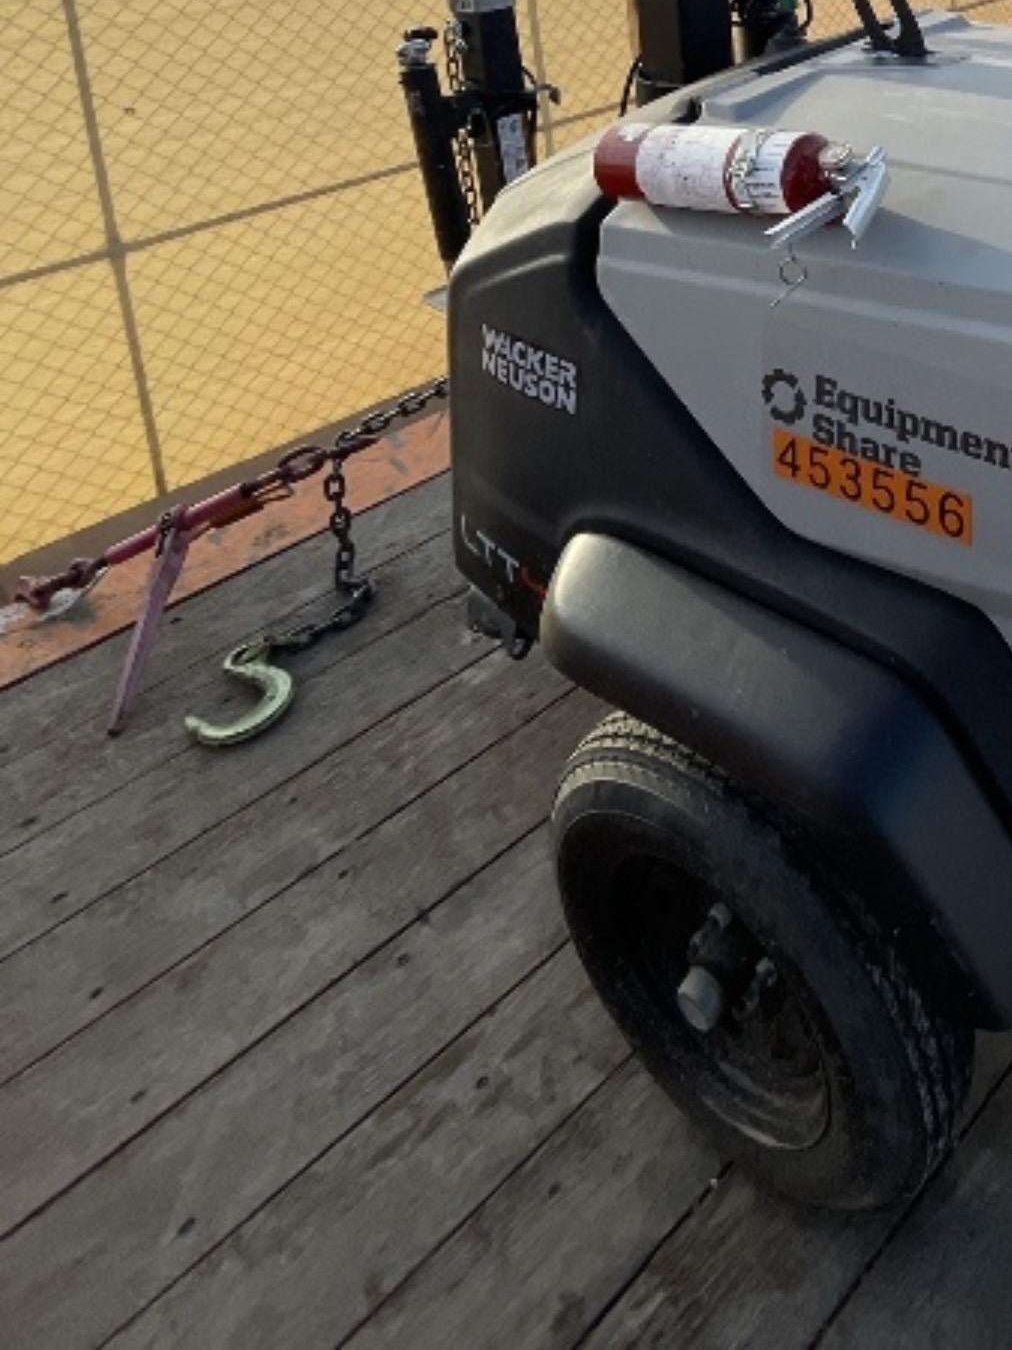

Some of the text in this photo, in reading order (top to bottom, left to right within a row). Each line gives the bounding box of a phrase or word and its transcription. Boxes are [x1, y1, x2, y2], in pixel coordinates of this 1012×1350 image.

[482, 323, 577, 388] WACKER
[482, 348, 577, 415] NEUSON
[812, 413, 921, 477] Share
[777, 438, 964, 538] 453556
